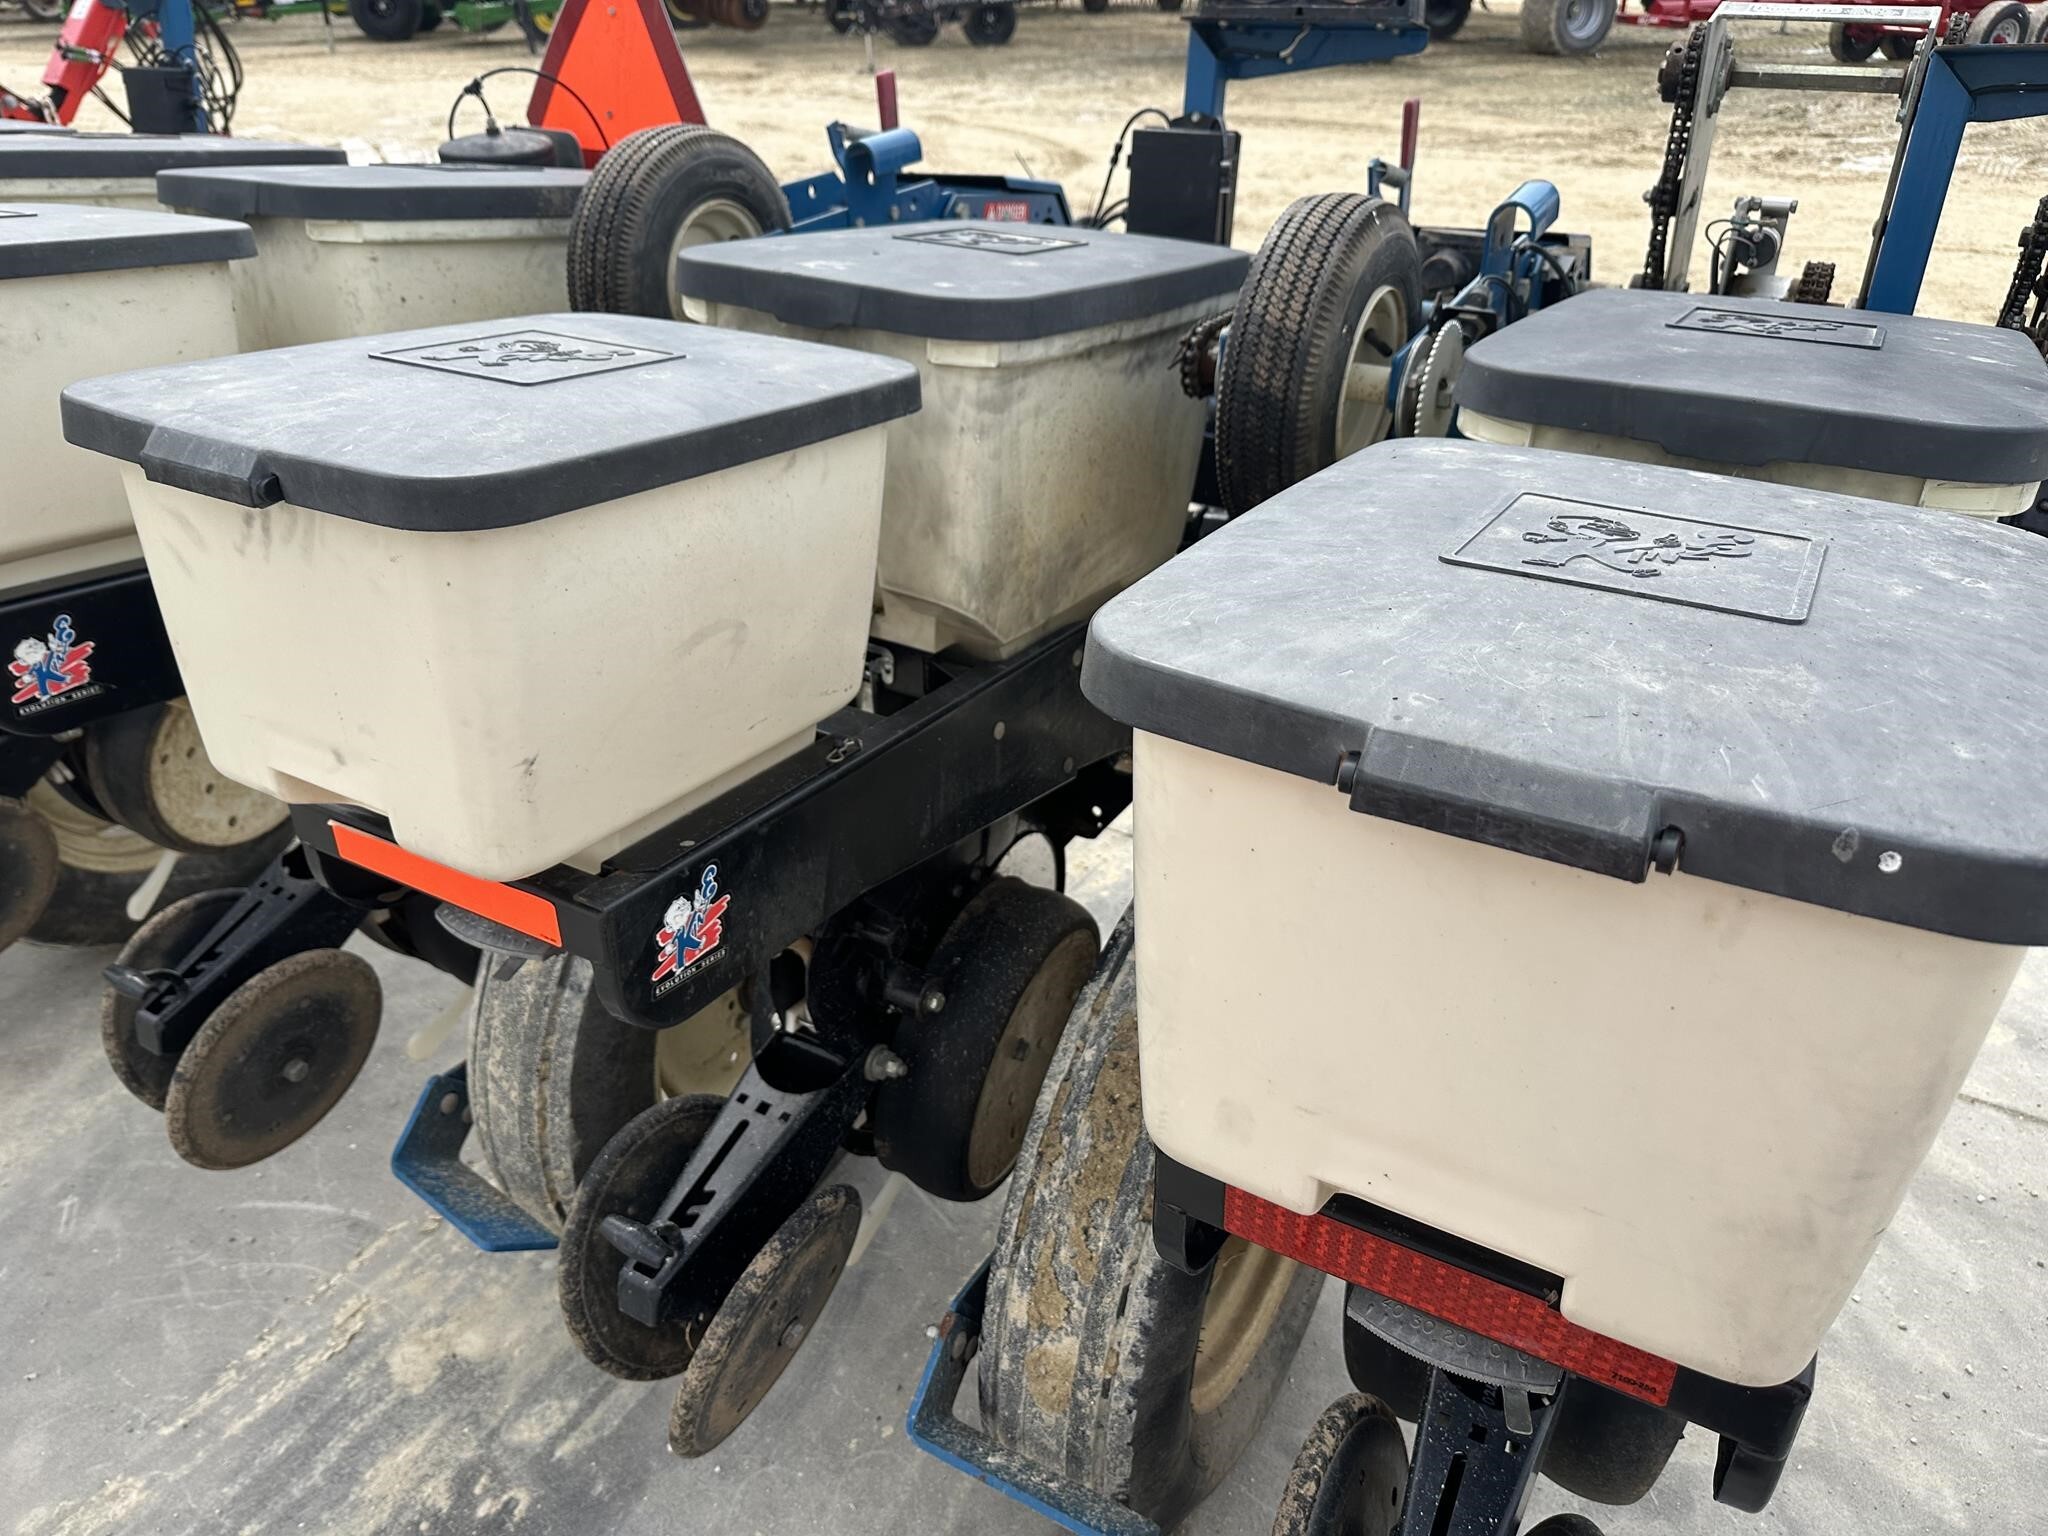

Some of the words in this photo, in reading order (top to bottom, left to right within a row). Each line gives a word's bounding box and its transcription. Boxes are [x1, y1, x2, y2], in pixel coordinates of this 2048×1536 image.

[656, 966, 697, 995] EVOLUTION
[701, 949, 726, 968] SERIES
[1410, 1314, 1436, 1334] 30
[1442, 1328, 1468, 1348] 20
